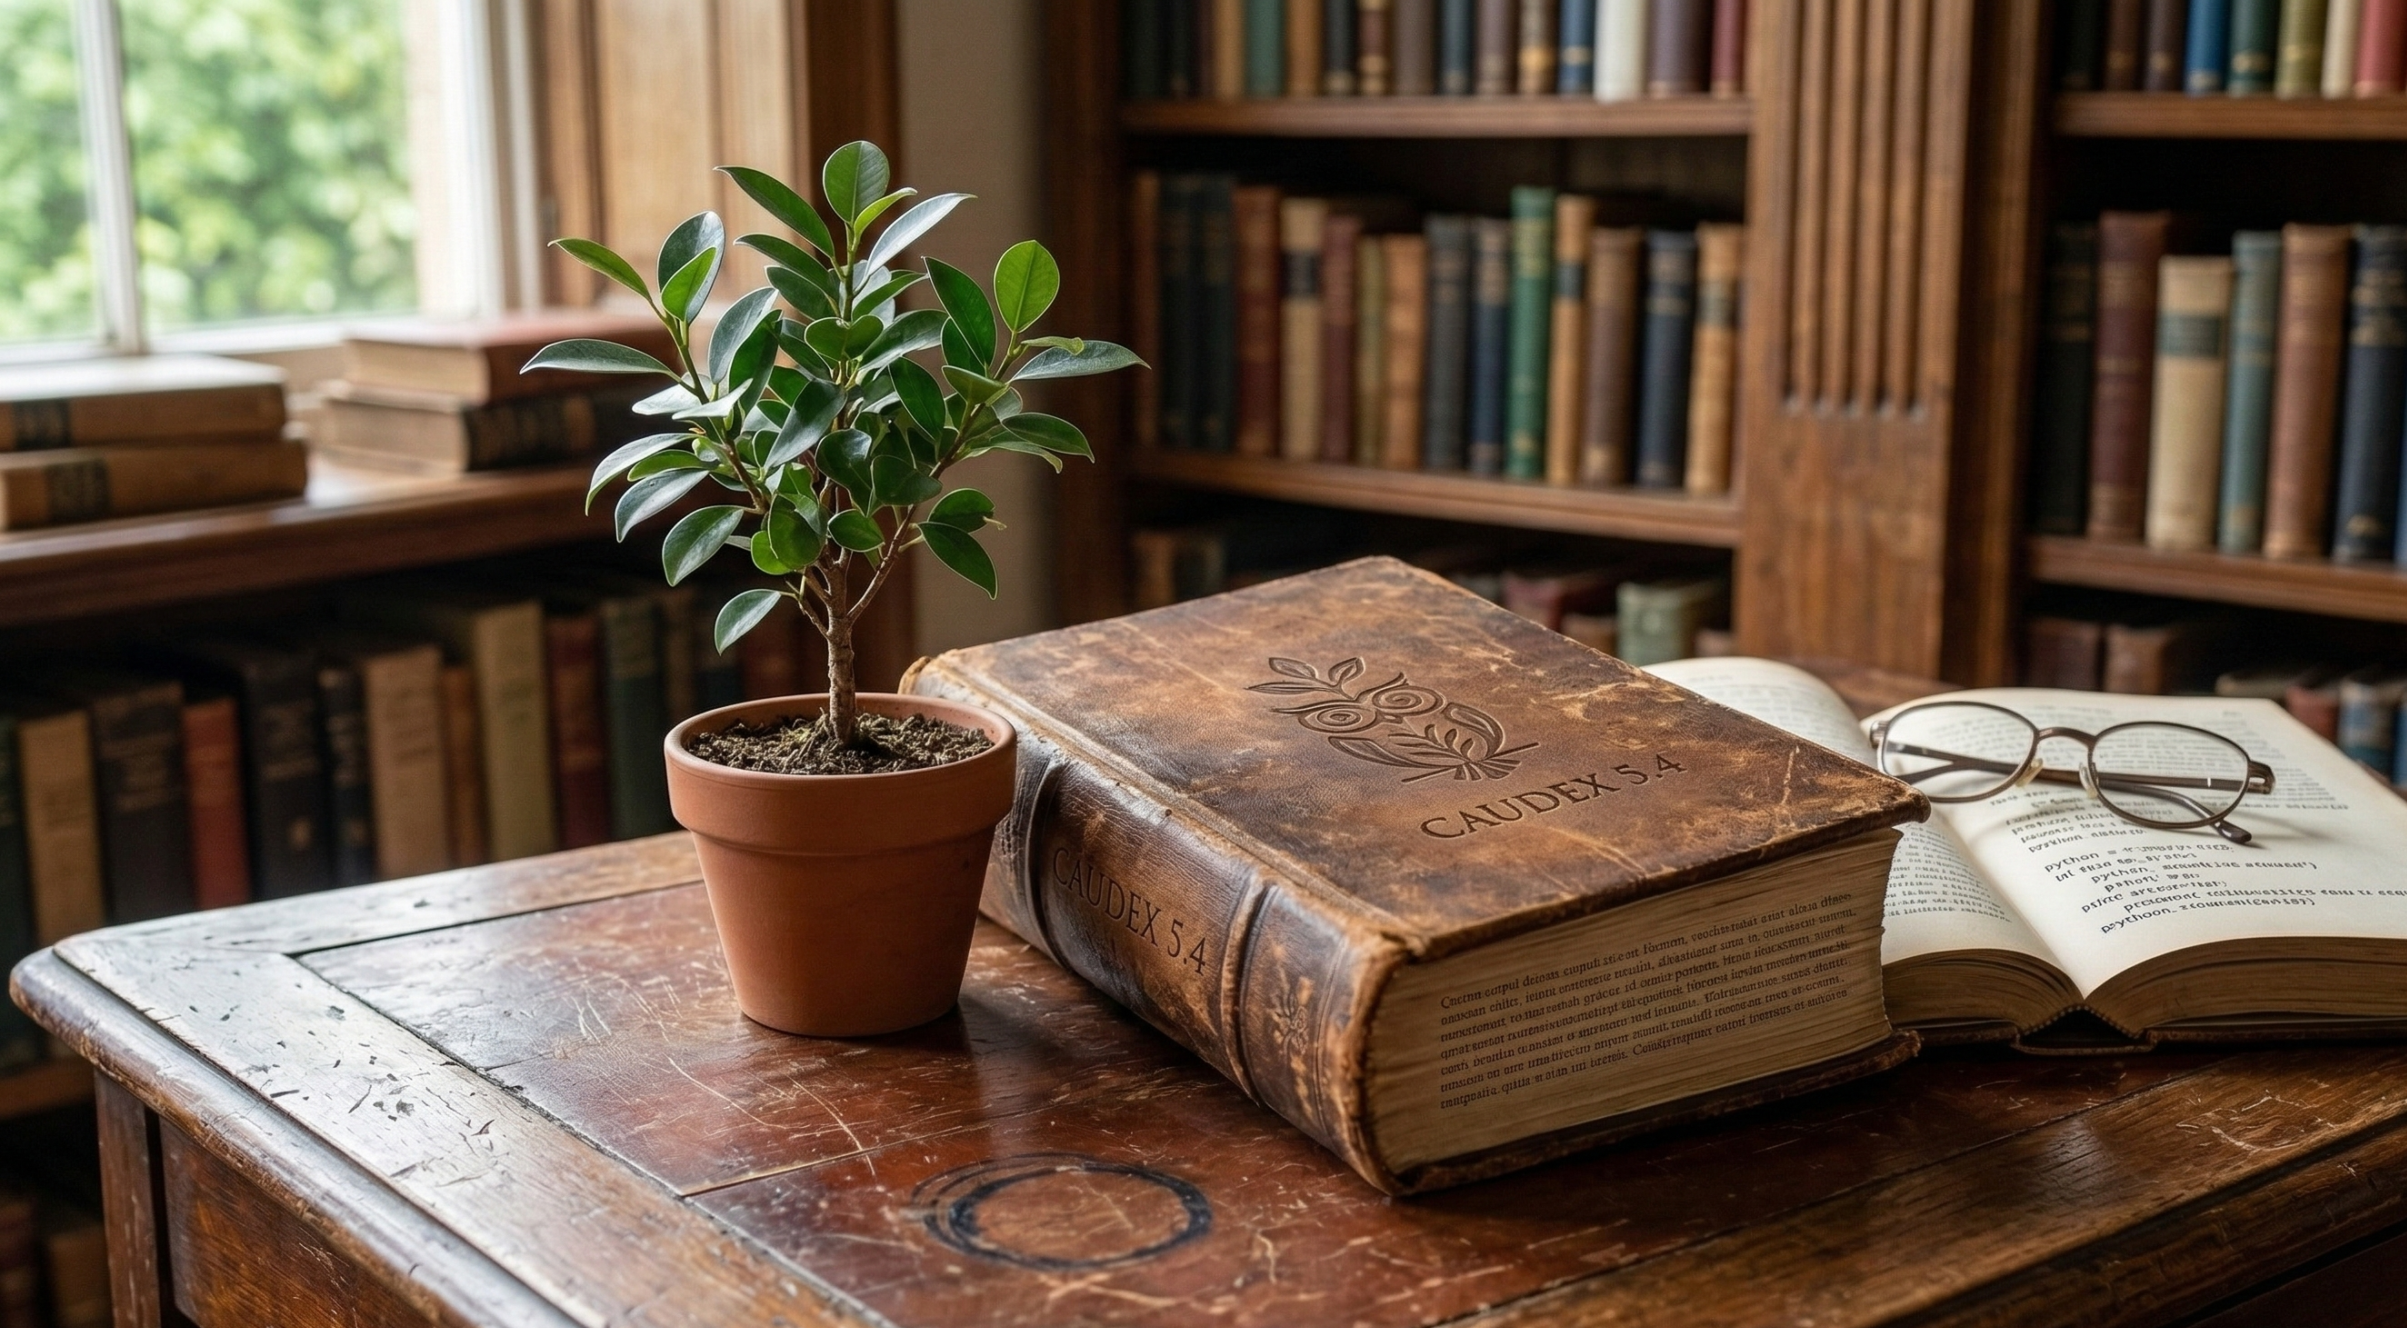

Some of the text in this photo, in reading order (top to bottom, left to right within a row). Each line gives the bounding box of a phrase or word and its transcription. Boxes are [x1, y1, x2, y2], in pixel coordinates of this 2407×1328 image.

[1419, 752, 1688, 842] CAUDEX 5.4
[1051, 846, 1210, 976] CAUDEX 5.4
